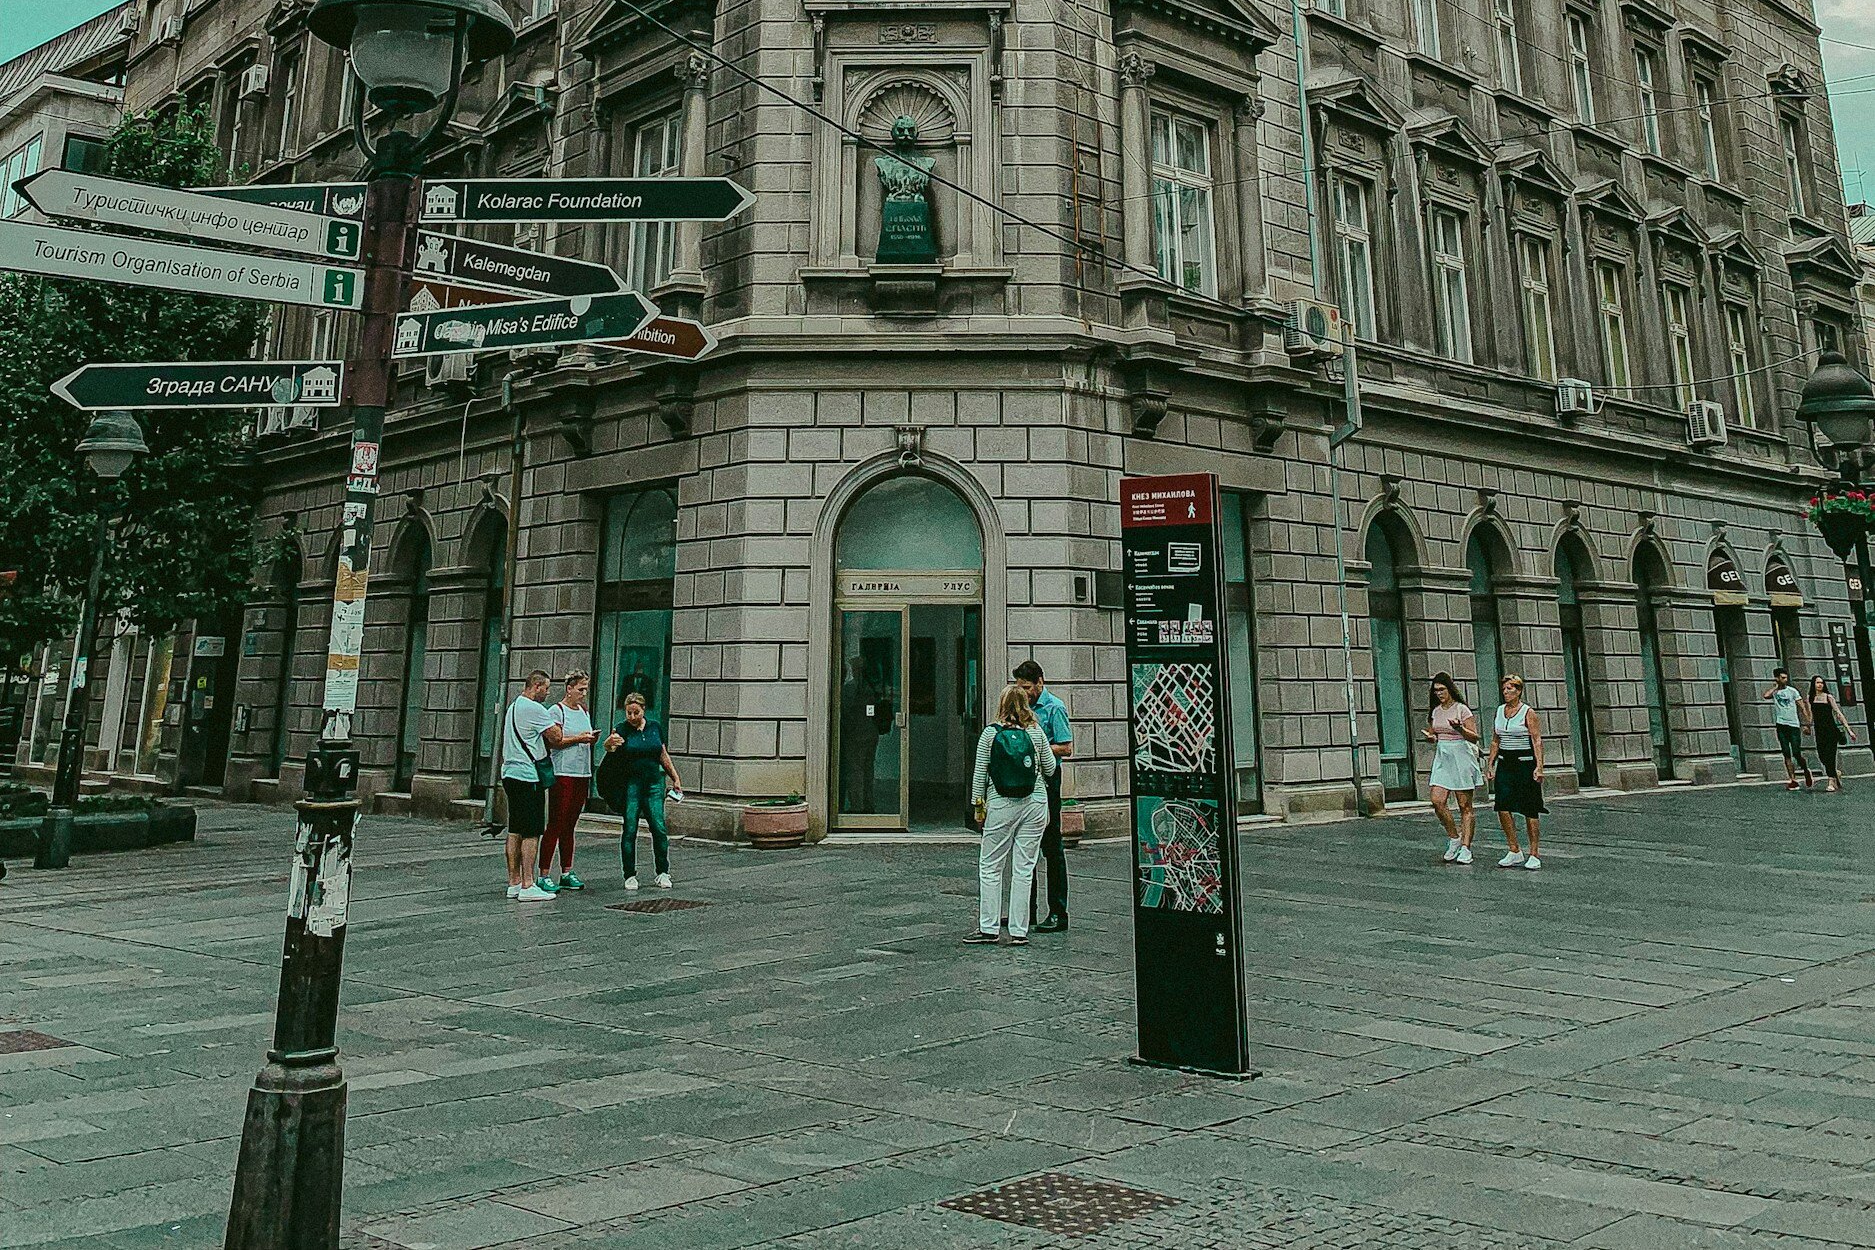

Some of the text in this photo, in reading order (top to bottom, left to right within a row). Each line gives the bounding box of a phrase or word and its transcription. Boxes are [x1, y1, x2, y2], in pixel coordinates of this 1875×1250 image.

[477, 193, 642, 209] Kolarac Foundation
[73, 187, 309, 242] Туристички инфо центар
[34, 239, 106, 265] Tourism
[227, 267, 245, 283] of
[248, 268, 300, 290] Serbia
[463, 252, 551, 283] Kalemegdan
[486, 317, 529, 336] Misa's
[531, 313, 579, 332] Edifice
[146, 375, 279, 397] Зграда САНУ
[1131, 490, 1196, 501] КНЕЗ МИХАИЛОВА
[943, 582, 971, 591] УЛУС
